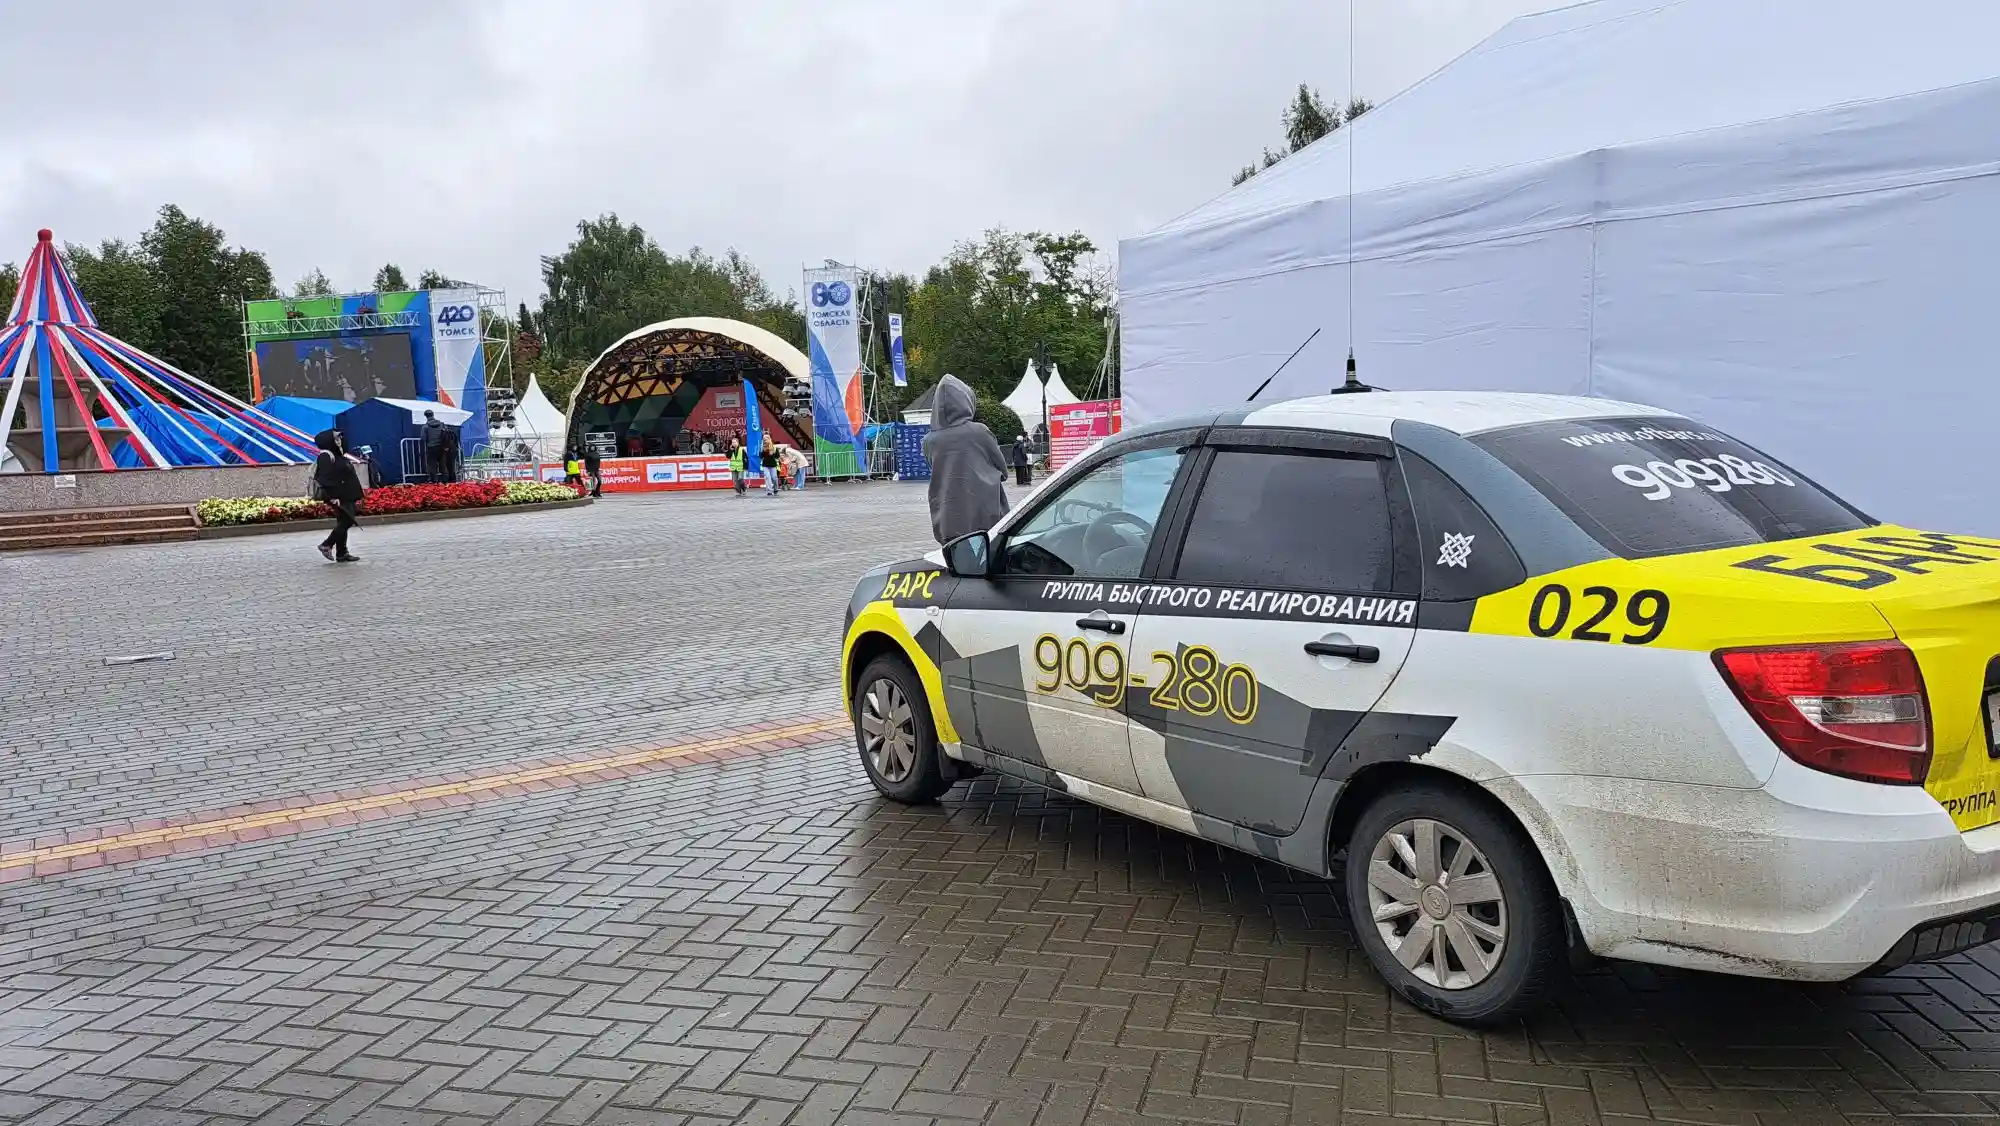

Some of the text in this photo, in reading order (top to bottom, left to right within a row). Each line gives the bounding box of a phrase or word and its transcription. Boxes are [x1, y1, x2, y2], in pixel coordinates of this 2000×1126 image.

[811, 281, 851, 307] 80
[438, 305, 474, 326] 420
[811, 309, 851, 318] ТОМСКАЯ
[439, 328, 476, 337] ТОМСК
[1611, 454, 1796, 500] 909280
[881, 570, 941, 599] БАРС
[1041, 582, 1417, 624] ГРУППА БЫСТРОГО РЕАГИРОВАНИЯ
[1528, 584, 1670, 644] 029
[1034, 633, 1260, 725] 909-280
